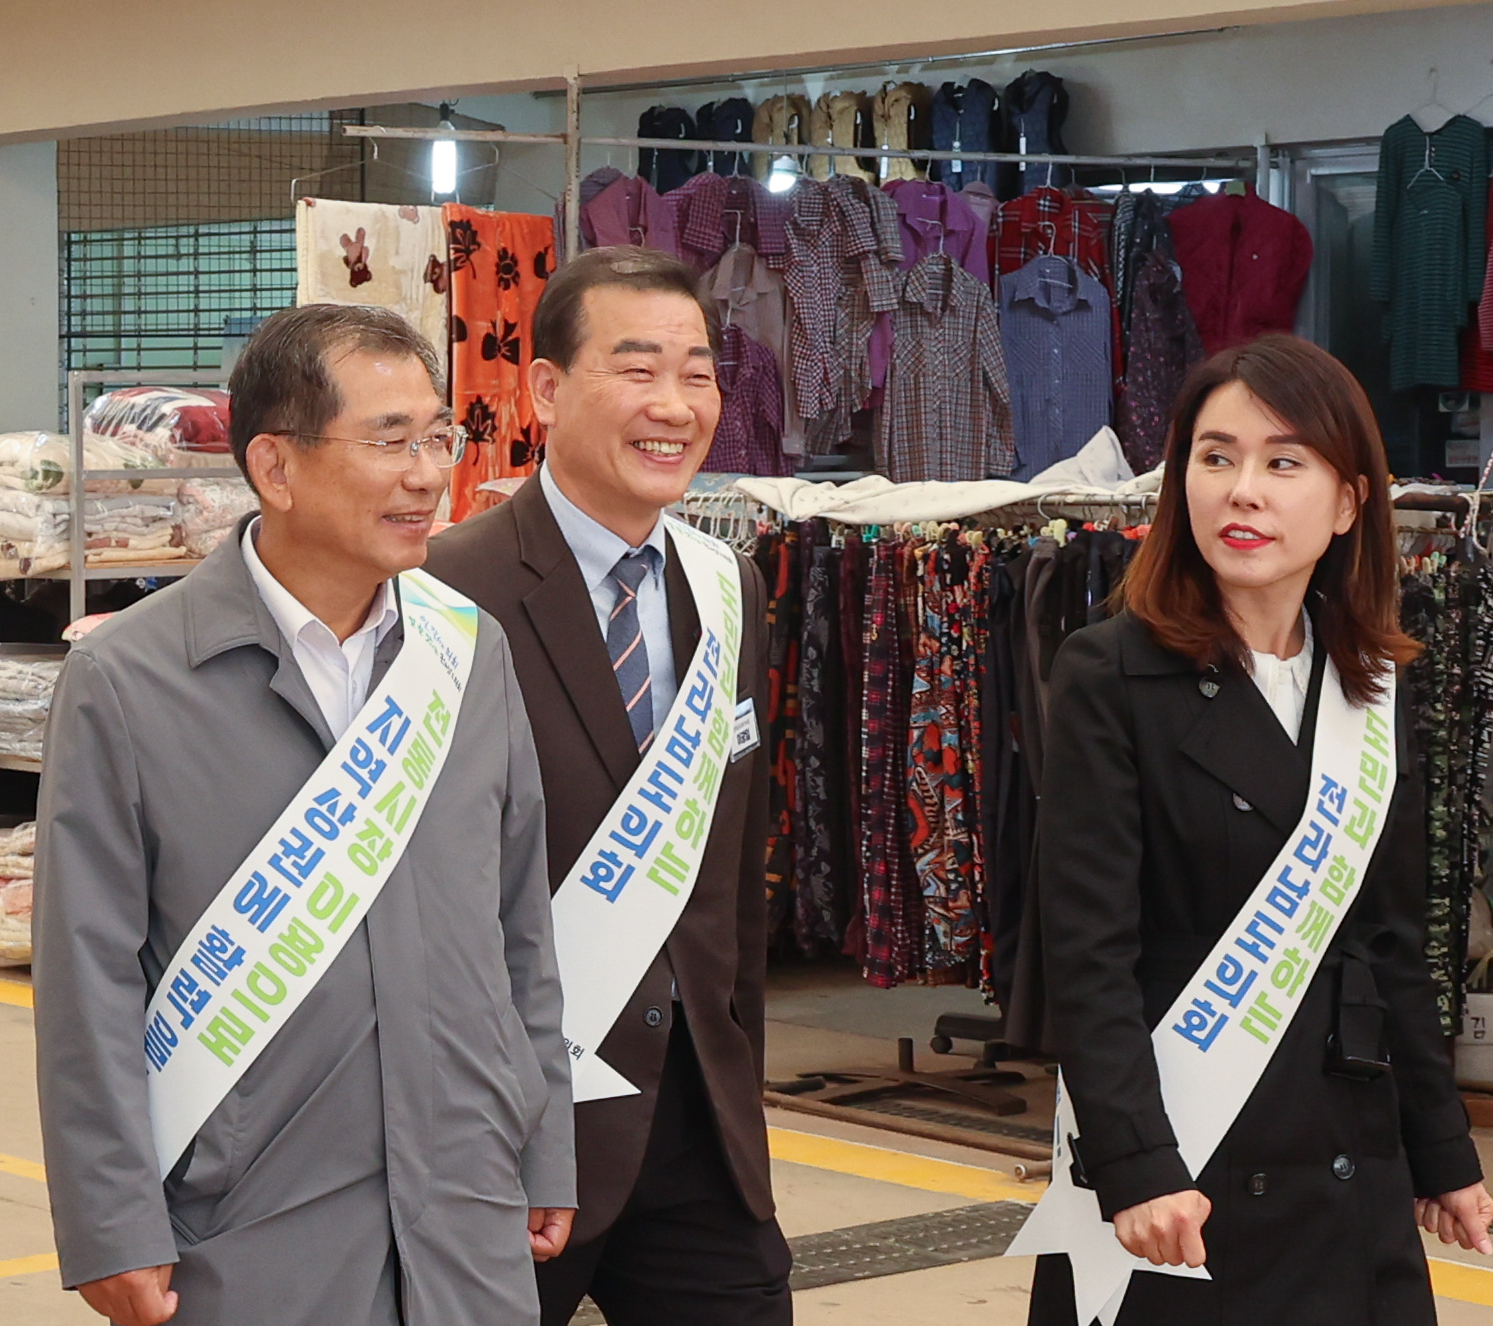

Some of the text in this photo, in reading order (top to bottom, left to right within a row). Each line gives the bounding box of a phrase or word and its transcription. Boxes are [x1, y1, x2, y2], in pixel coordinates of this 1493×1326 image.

[232, 695, 412, 934] 지역상권에
[580, 627, 721, 903] 전라남도의회
[646, 570, 739, 896] 도민과 함께하는
[197, 689, 451, 1066] 전통시장 이용으로
[1171, 773, 1349, 1053] 전라남도의회
[1239, 854, 1357, 1044] 함께하는
